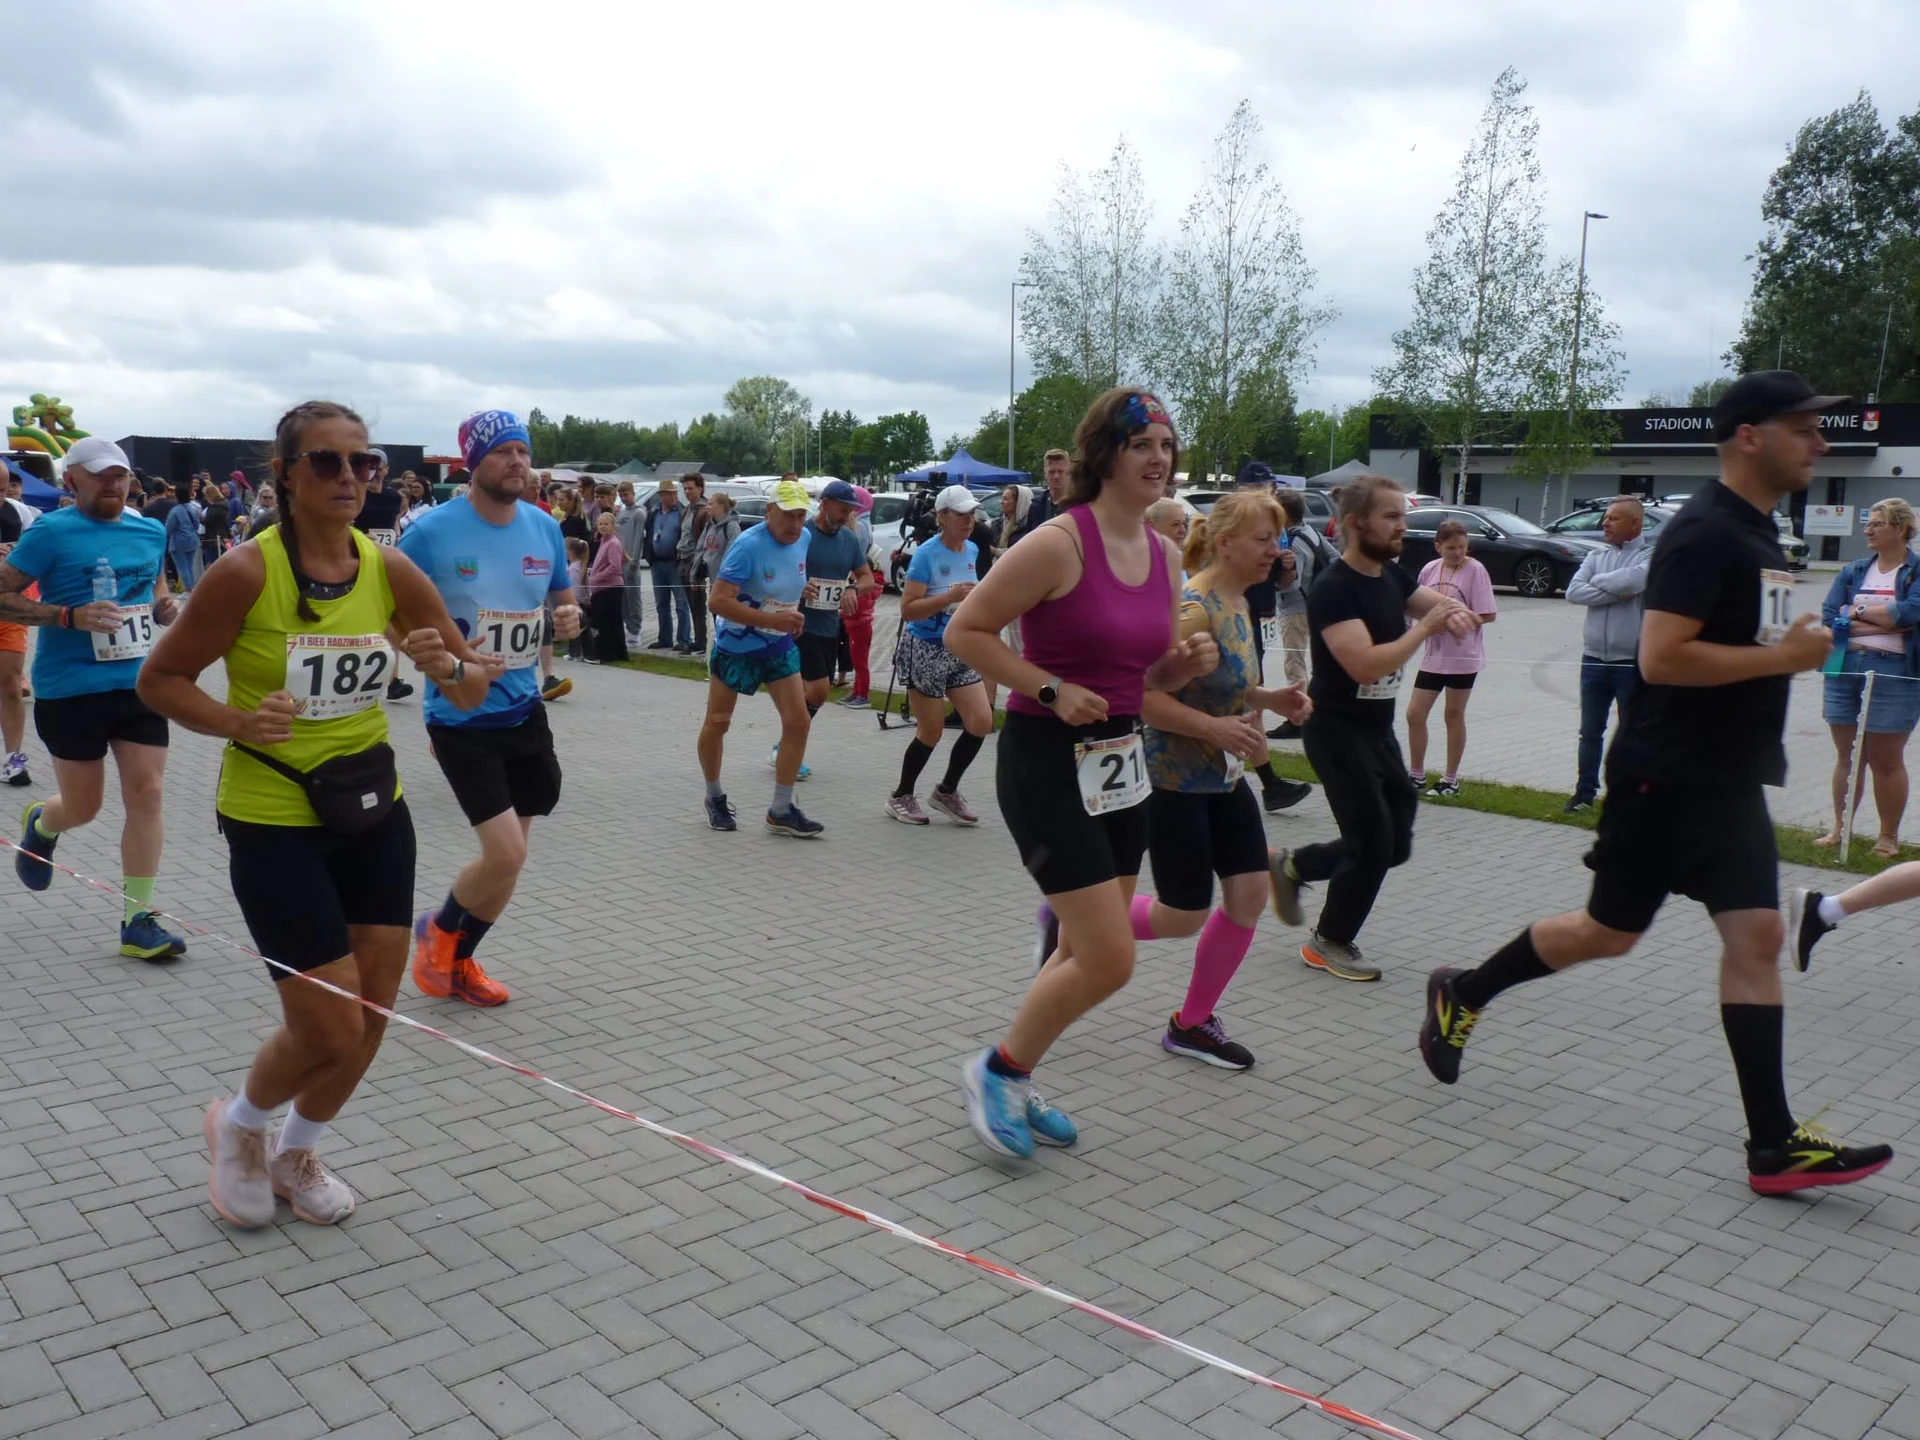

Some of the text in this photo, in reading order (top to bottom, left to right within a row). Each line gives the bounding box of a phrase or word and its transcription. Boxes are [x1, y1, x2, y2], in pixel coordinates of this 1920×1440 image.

[464, 411, 499, 453] BIEG
[1644, 417, 1702, 430] STADION
[1817, 414, 1860, 428] ZYNIE
[376, 533, 392, 546] 73
[307, 636, 325, 647] BIEG
[487, 619, 541, 654] 104
[302, 650, 388, 697] 182
